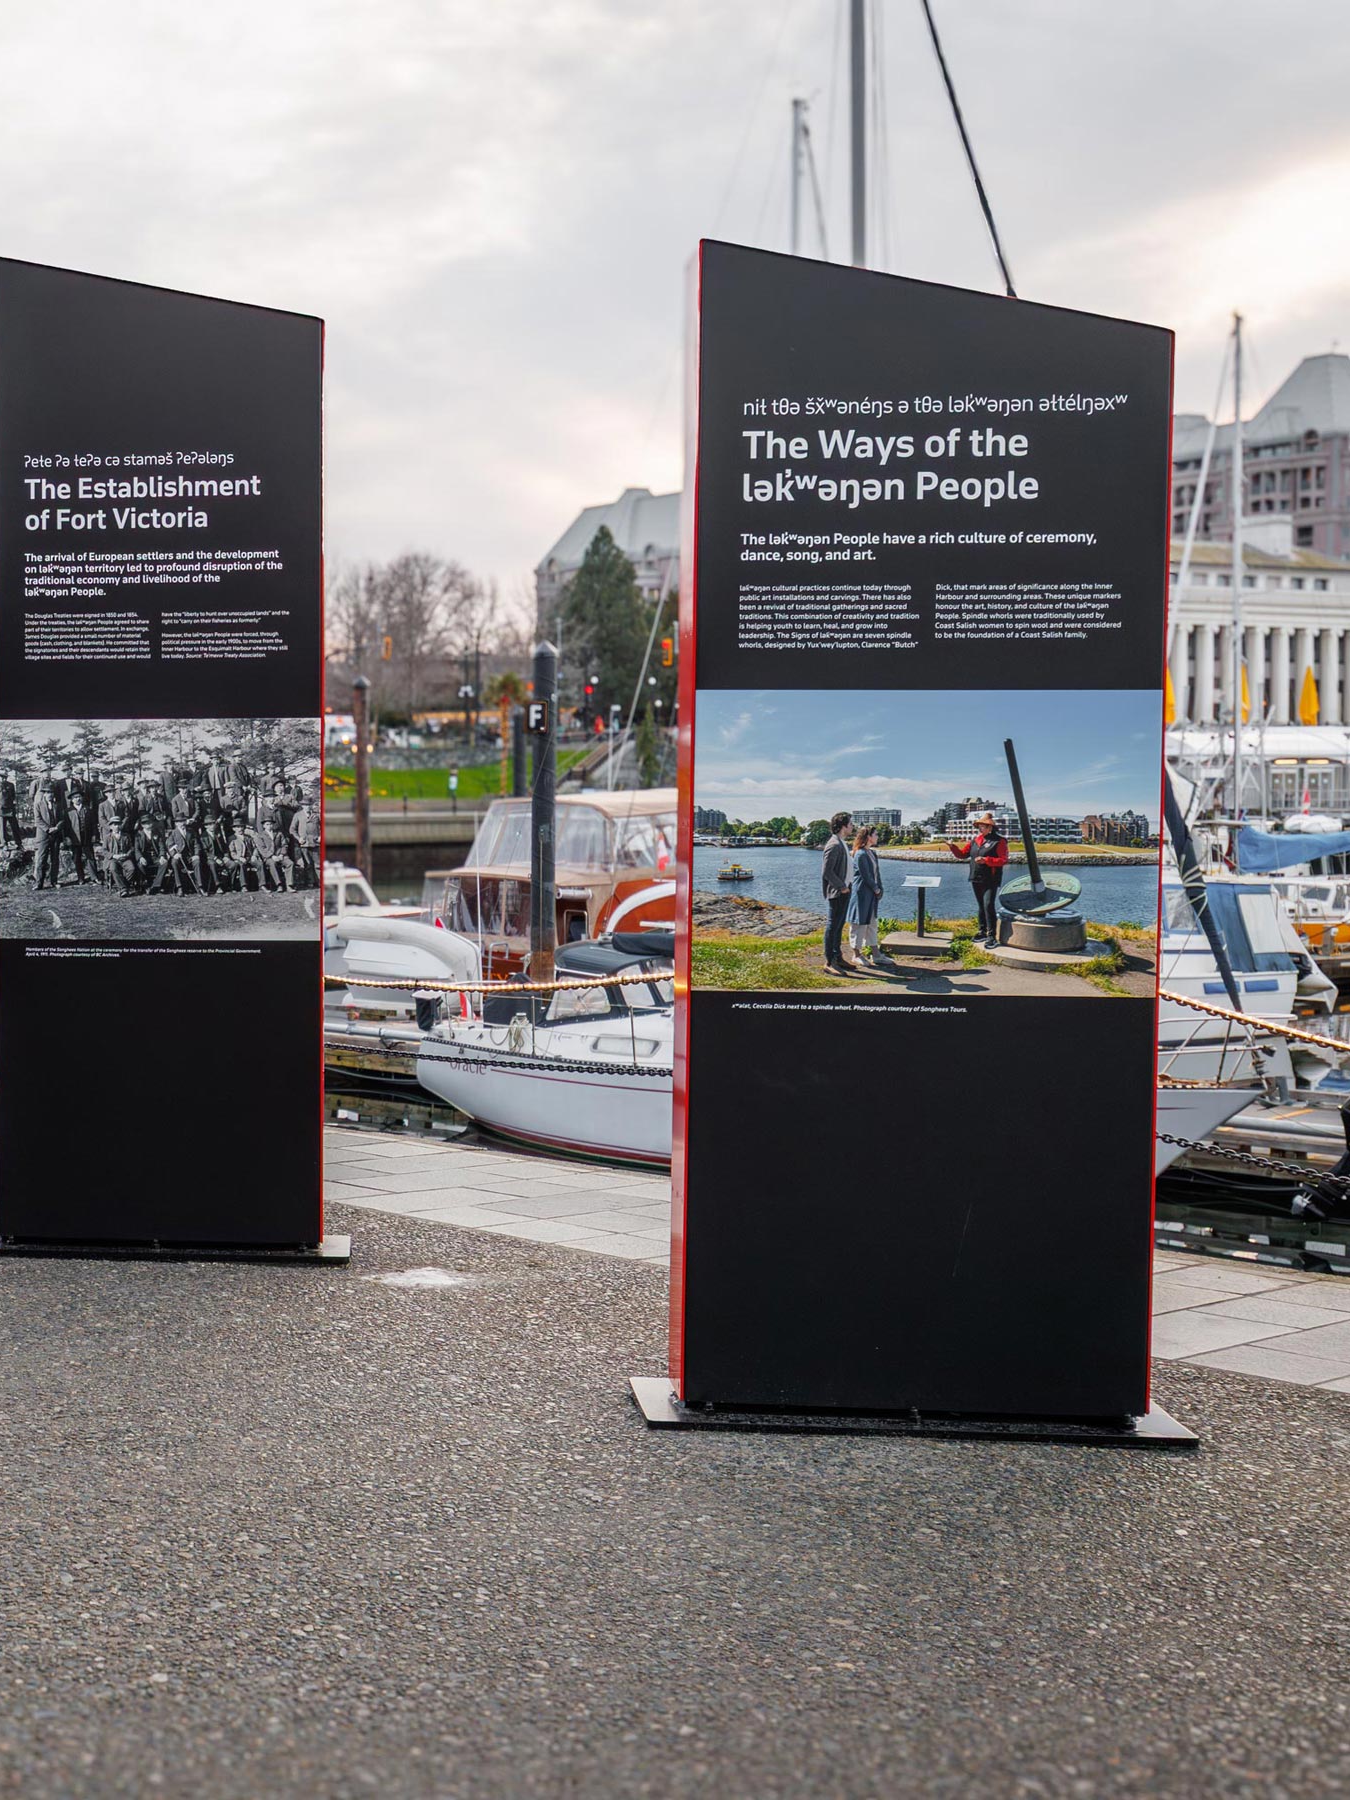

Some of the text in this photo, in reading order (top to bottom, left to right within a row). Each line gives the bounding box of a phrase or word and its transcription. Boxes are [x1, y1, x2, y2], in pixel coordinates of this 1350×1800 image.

[742, 427, 1029, 465] The Ways of the
[24, 474, 261, 500] The Establishment
[915, 469, 1040, 508] People
[24, 506, 208, 531] of Fort Victoria
[740, 531, 766, 545] The
[834, 530, 880, 548] People
[883, 530, 916, 545] have
[918, 533, 926, 544] a
[930, 530, 955, 544] rich
[958, 530, 1006, 544] culture
[1009, 529, 1024, 544] of
[1026, 532, 1097, 547] ceremony,
[24, 548, 279, 563] The arrival of European settlers and the development
[740, 547, 876, 564] dance, song, and art.
[24, 565, 37, 574] on
[84, 562, 125, 575] territory
[126, 562, 142, 572] led
[144, 562, 155, 572] to
[156, 561, 201, 574] profound
[202, 560, 253, 573] disruption
[254, 560, 265, 570] of
[266, 560, 283, 570] the
[24, 572, 221, 586] traditional economy and livelihood of the
[799, 584, 831, 592] practices
[863, 584, 883, 592] today
[884, 583, 911, 592] through
[71, 586, 106, 598] People.
[529, 703, 543, 729] F
